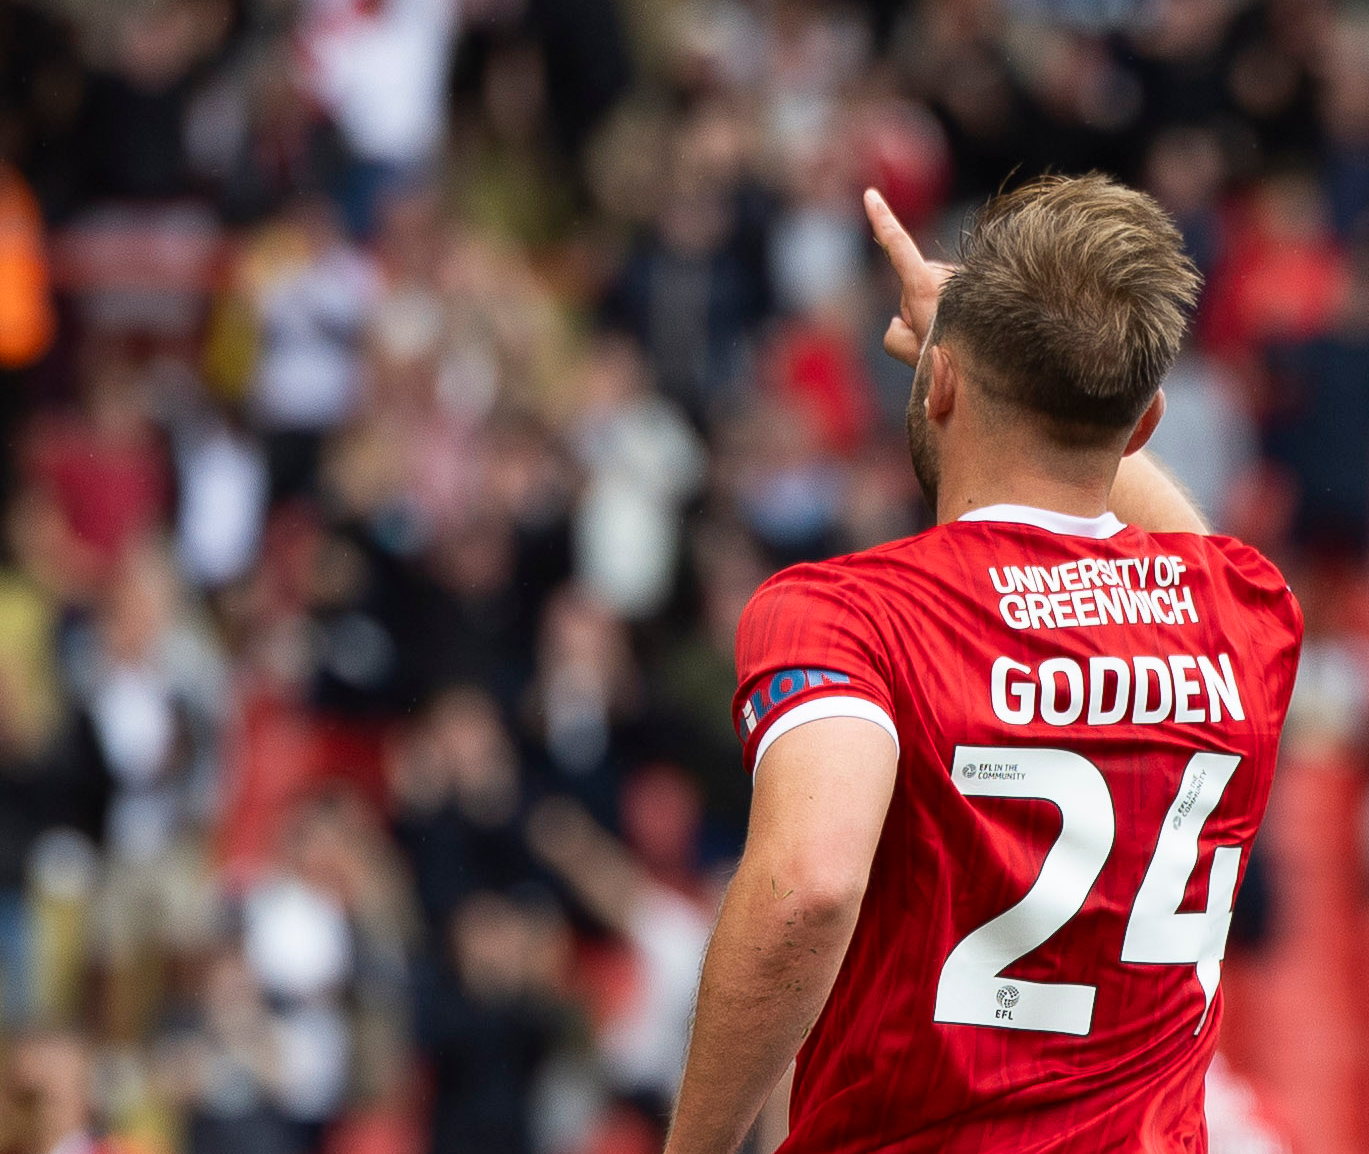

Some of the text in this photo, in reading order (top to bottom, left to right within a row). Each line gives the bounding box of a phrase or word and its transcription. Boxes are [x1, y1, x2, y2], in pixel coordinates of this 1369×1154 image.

[988, 555, 1187, 594] UNIVERSITY OF
[998, 586, 1200, 630] GREENWICH
[990, 653, 1246, 727] GODDEN
[978, 772, 1026, 780] COMMUNITY
[979, 763, 1019, 772] EFL IN THE
[1182, 769, 1207, 817] COMMUNITY
[934, 745, 1243, 1036] 24
[995, 1009, 1014, 1021] EFL
